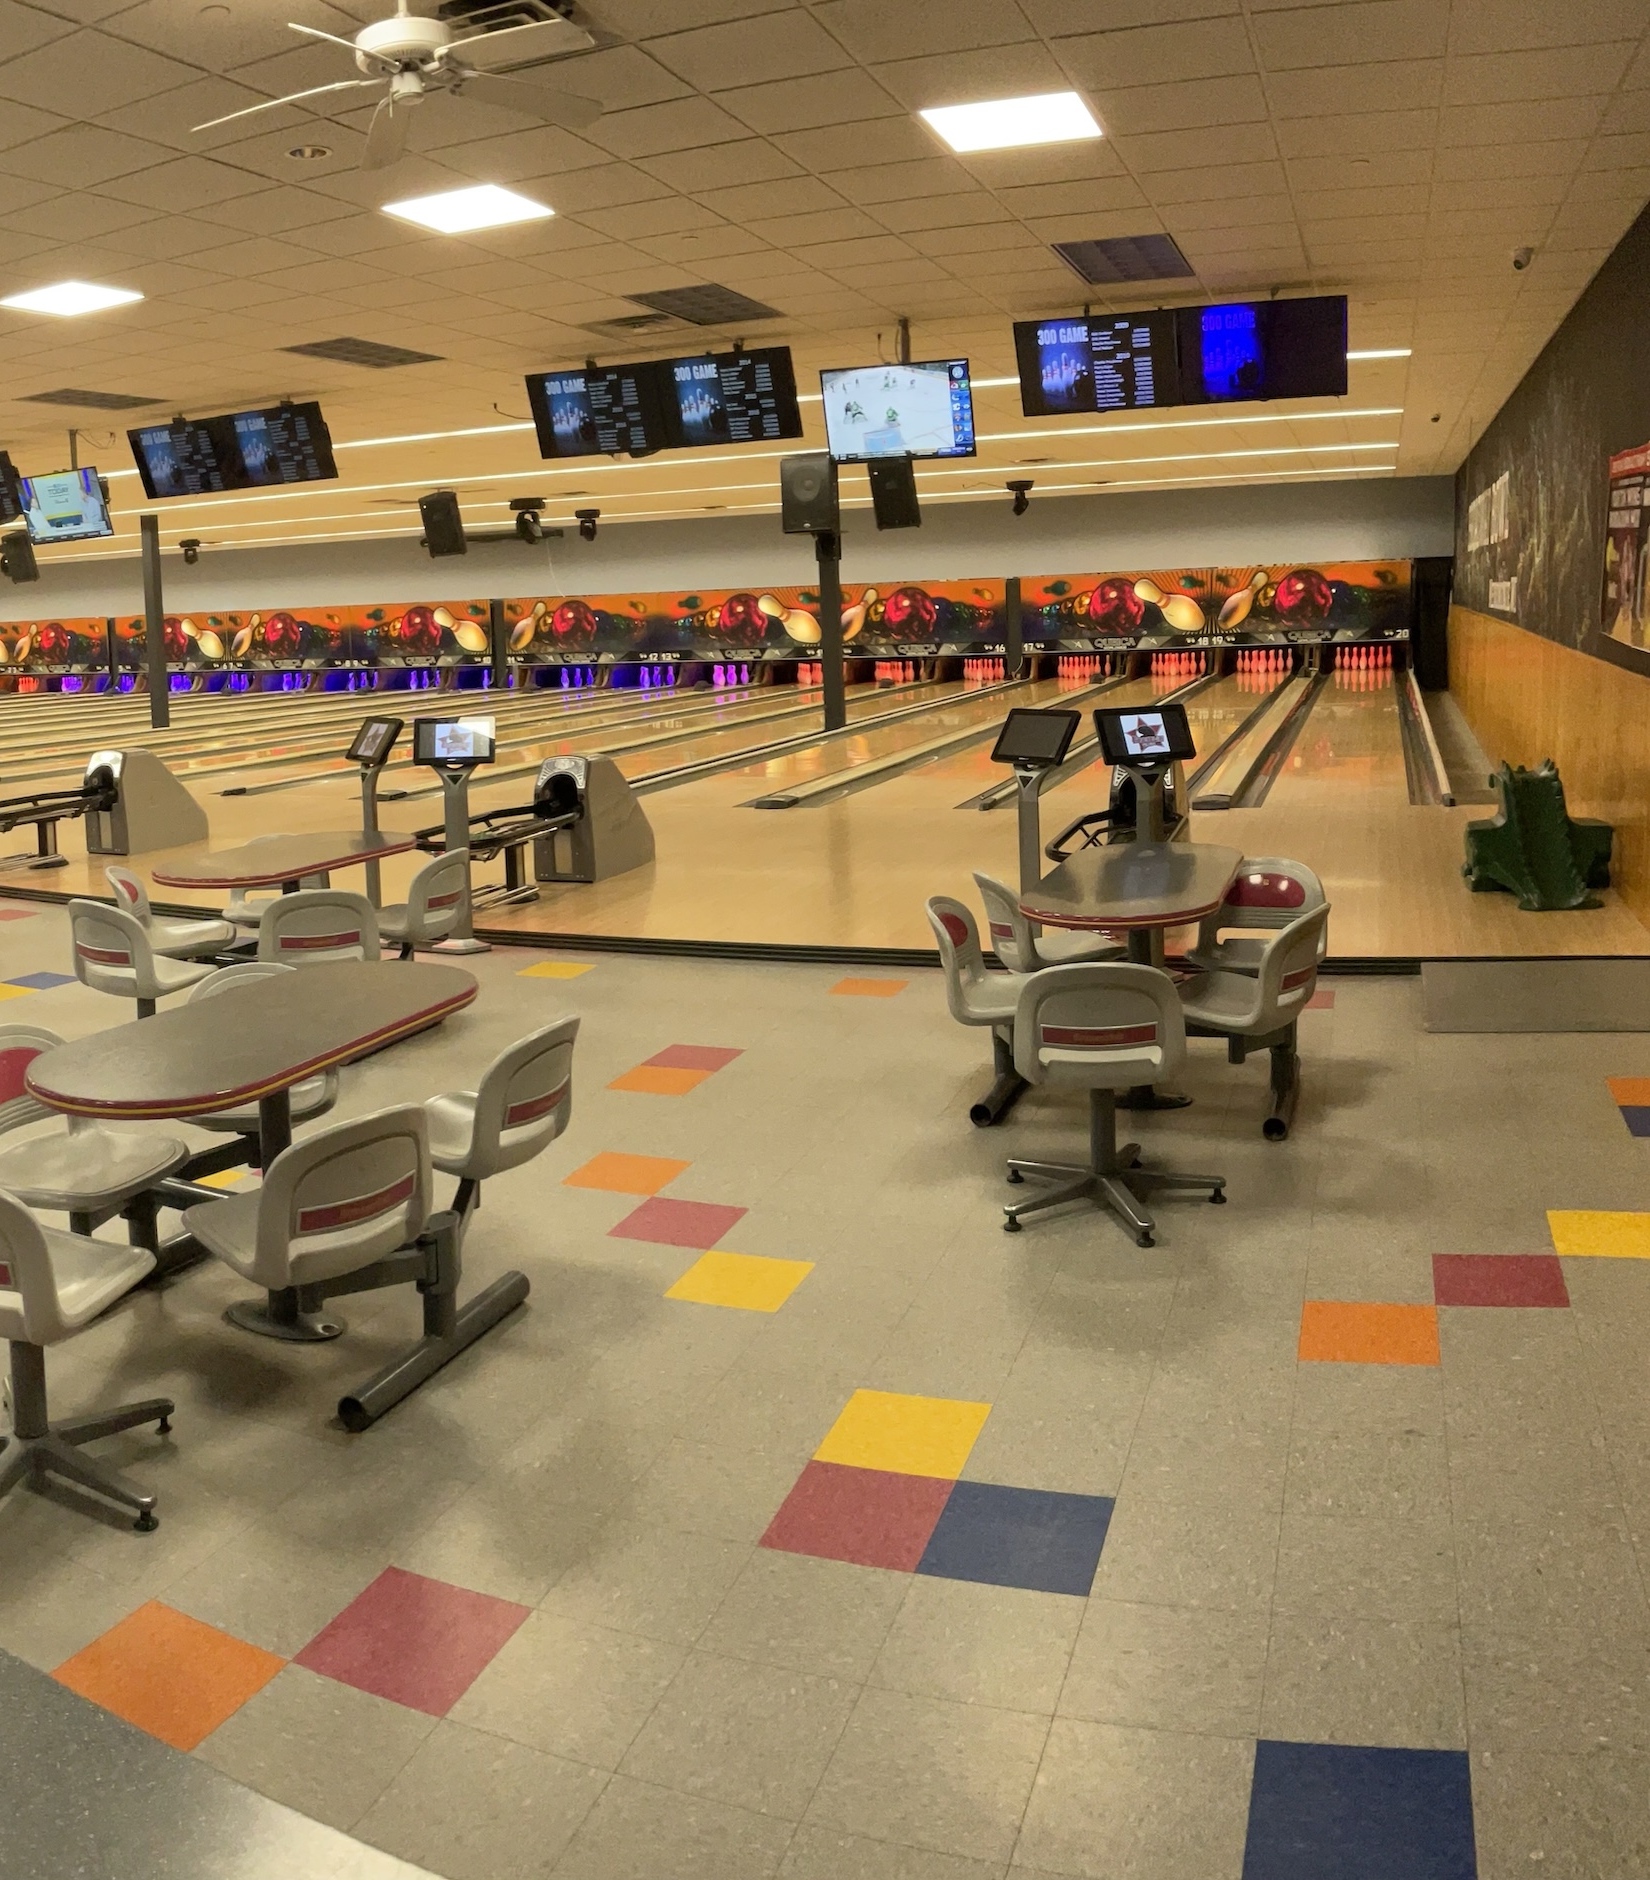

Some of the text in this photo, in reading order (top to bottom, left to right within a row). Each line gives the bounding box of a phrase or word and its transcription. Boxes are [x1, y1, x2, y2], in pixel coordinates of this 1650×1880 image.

[1201, 311, 1256, 332] 300 GAME
[1037, 325, 1089, 346] 300 GAME
[673, 363, 718, 382] 300 GAME
[545, 378, 587, 395] 300 GAME
[1396, 629, 1410, 639] 20
[1197, 636, 1223, 646] 18 19
[995, 644, 1006, 652] 16
[1023, 643, 1034, 652] 17
[649, 652, 672, 661] 12 13
